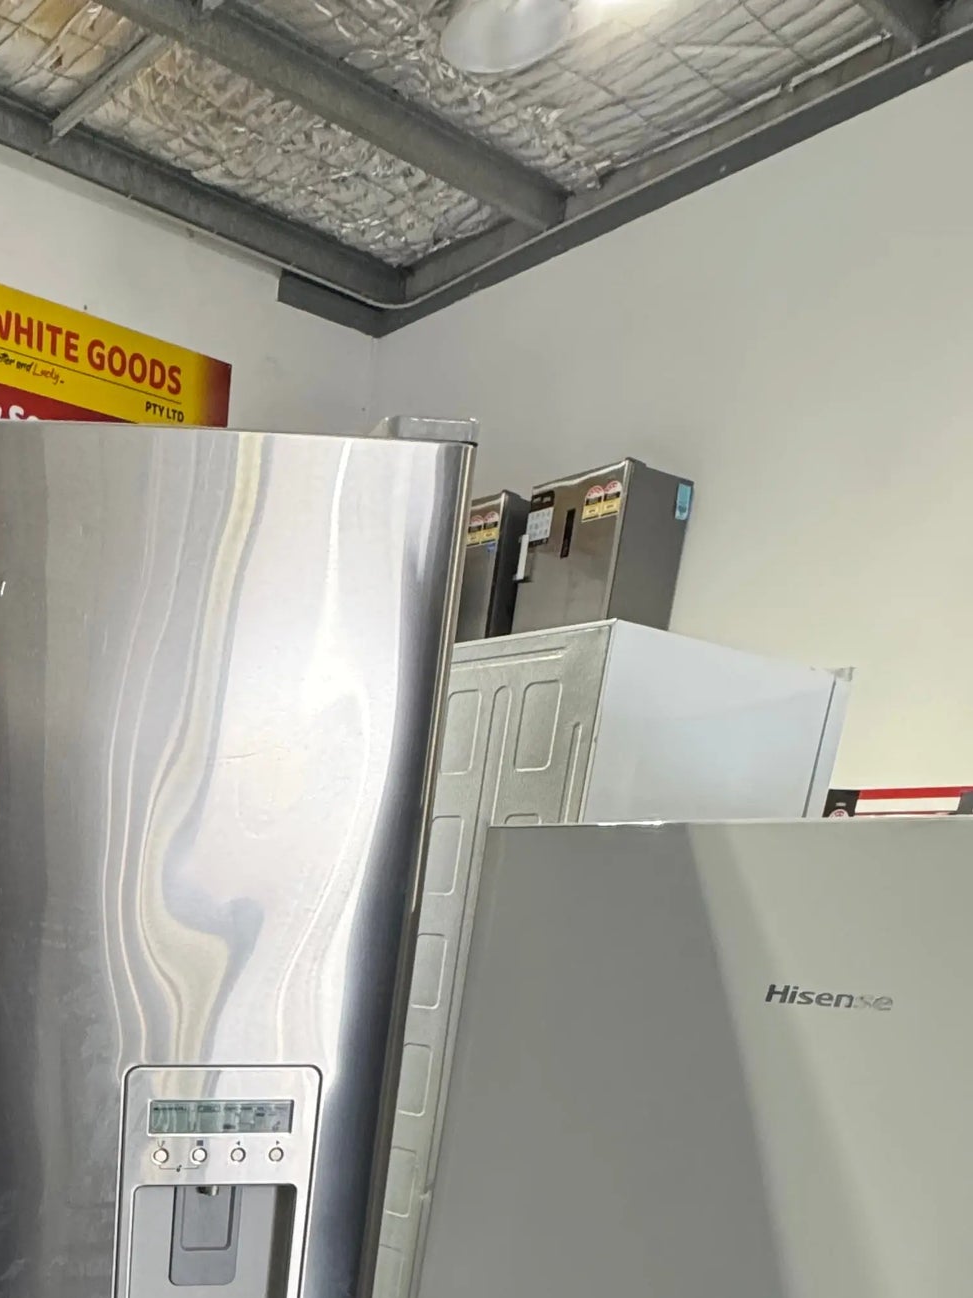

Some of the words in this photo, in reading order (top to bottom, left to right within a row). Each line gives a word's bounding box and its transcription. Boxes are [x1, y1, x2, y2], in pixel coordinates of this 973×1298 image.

[15, 361, 34, 373] and
[87, 339, 181, 395] GOODS
[145, 401, 165, 417] PTY
[166, 409, 184, 422] LTD
